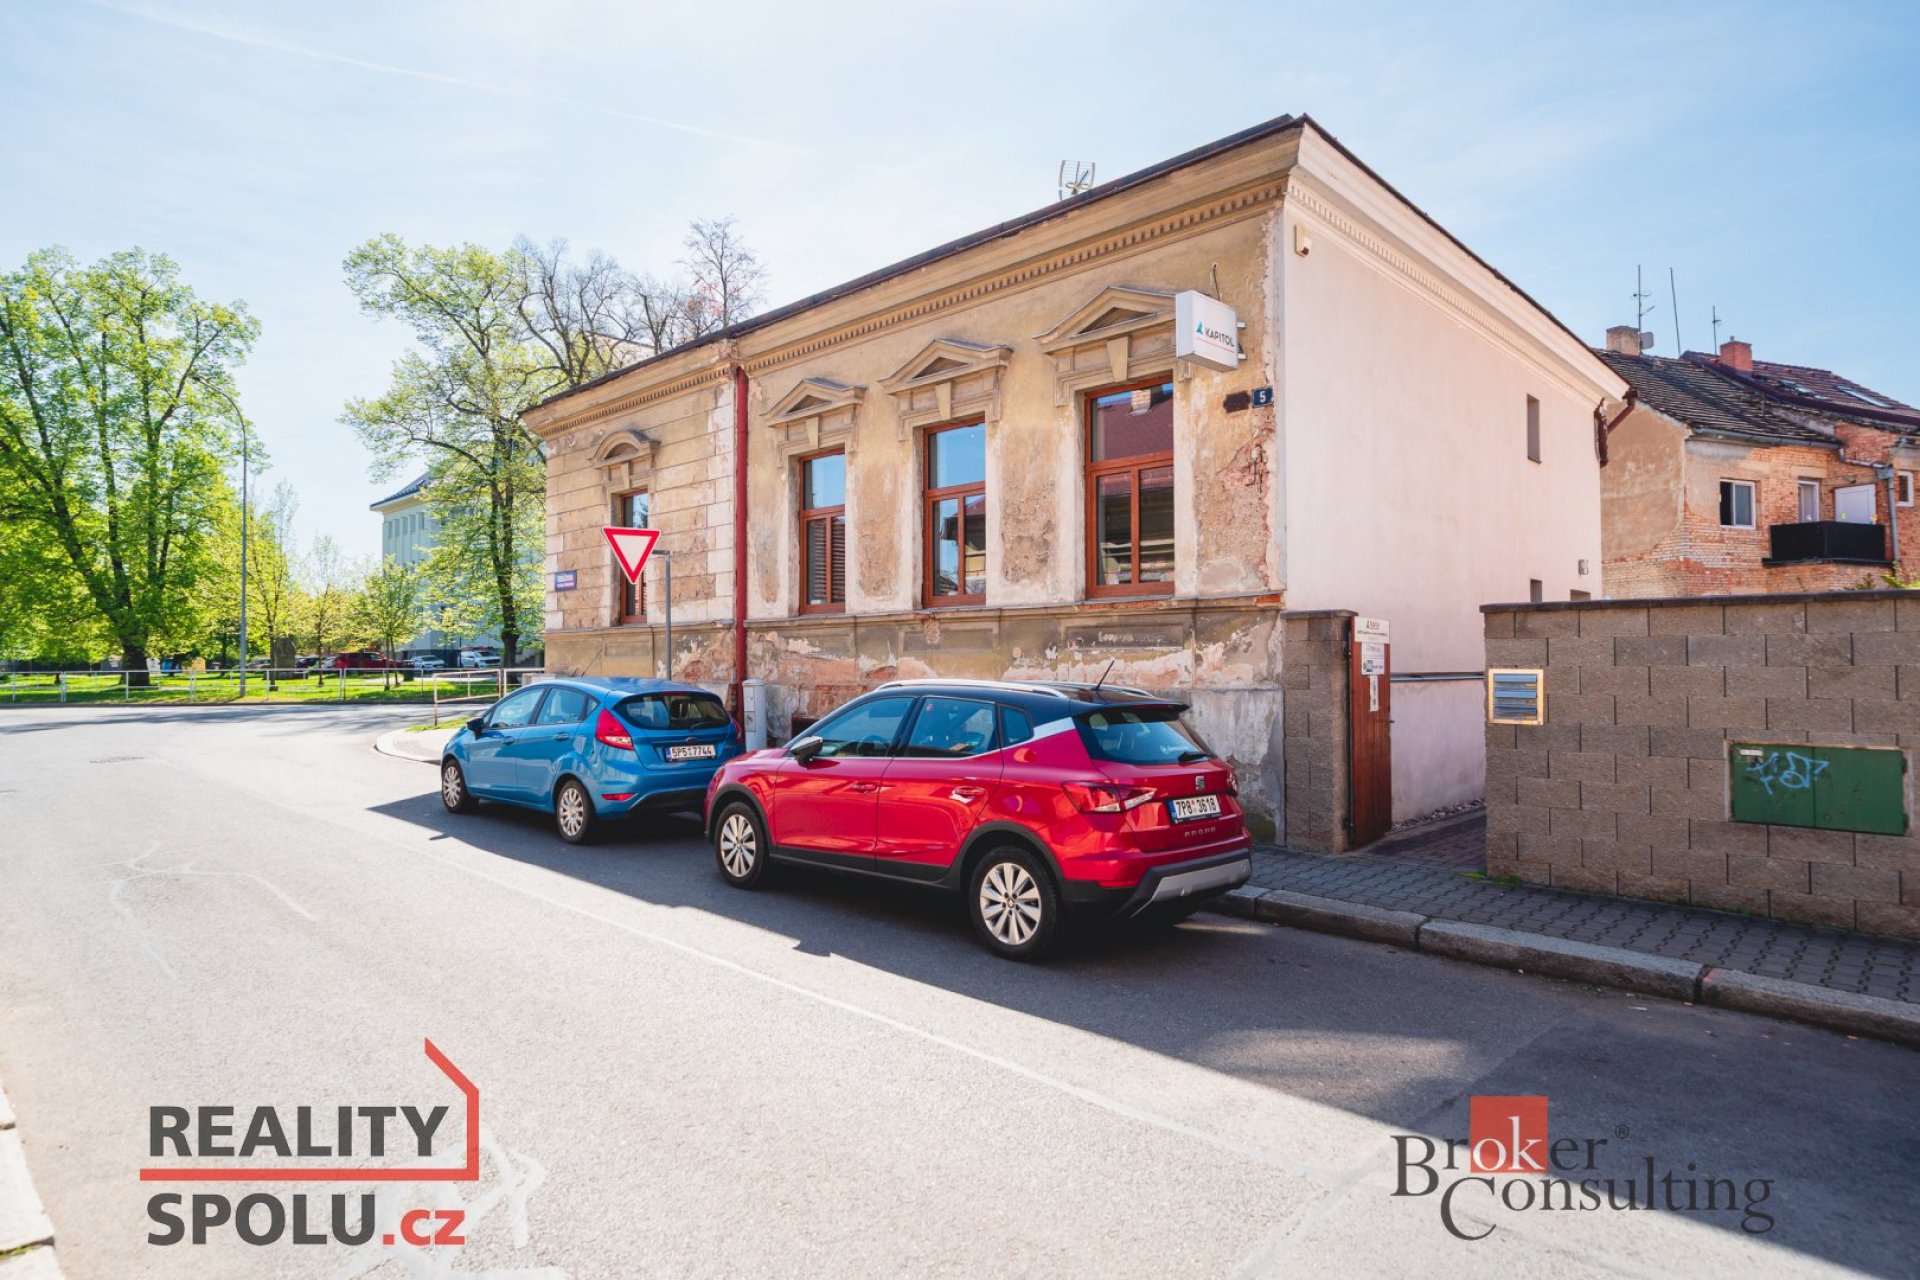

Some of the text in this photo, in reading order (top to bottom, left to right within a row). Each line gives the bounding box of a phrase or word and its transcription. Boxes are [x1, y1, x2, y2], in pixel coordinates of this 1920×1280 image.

[1205, 327, 1235, 347] KAPITOL
[1259, 391, 1267, 403] 5
[692, 746, 712, 756] 7744
[1176, 797, 1217, 816] 7P8 3618
